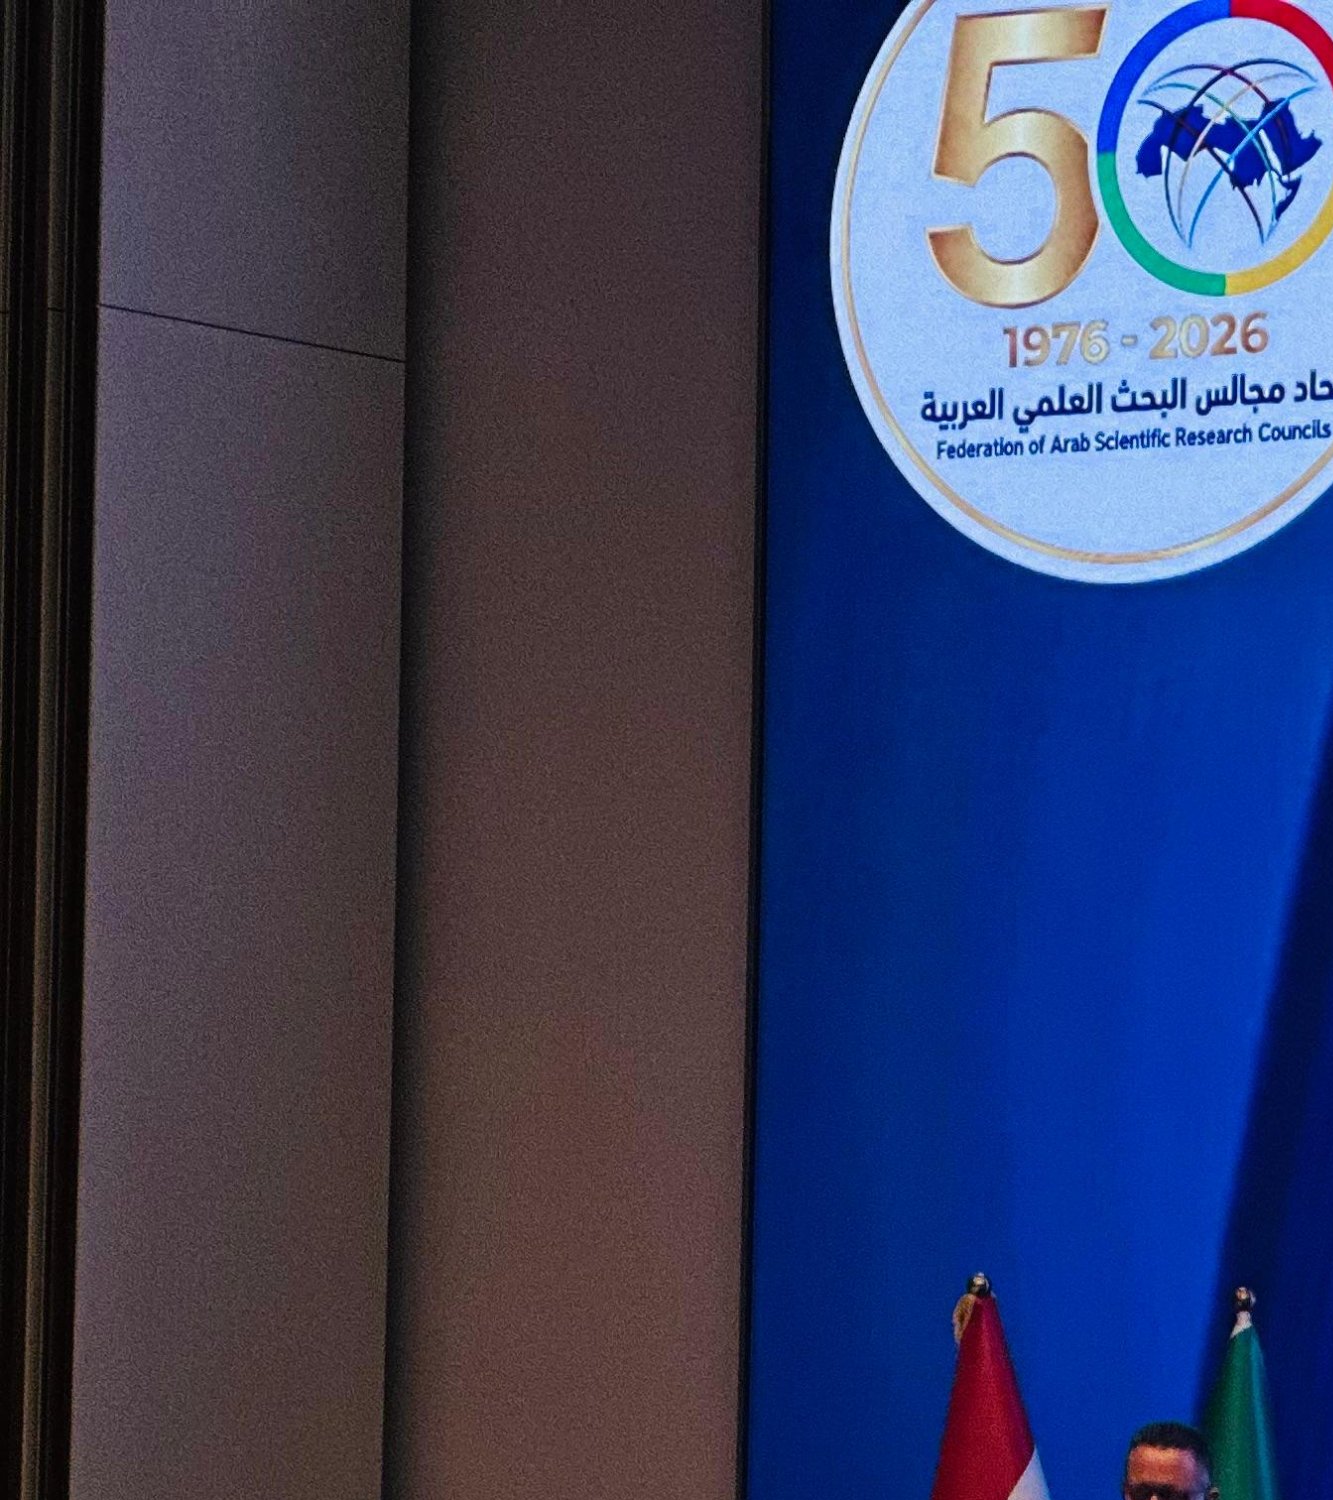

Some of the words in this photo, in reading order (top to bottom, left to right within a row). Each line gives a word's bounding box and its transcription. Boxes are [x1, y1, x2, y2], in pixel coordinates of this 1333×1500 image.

[1003, 319, 1111, 369] 1976
[1149, 311, 1271, 361] 2026
[920, 386, 1005, 431] العربية
[1012, 382, 1104, 434] العلمي
[1111, 378, 1188, 419] البحث
[1195, 372, 1286, 416] مجالس
[936, 437, 1025, 461] Federation
[1028, 434, 1047, 456] of
[1050, 432, 1091, 455] Arab
[1094, 426, 1171, 452] Scientific
[1174, 423, 1254, 448] Research
[1258, 419, 1332, 443] Councils
